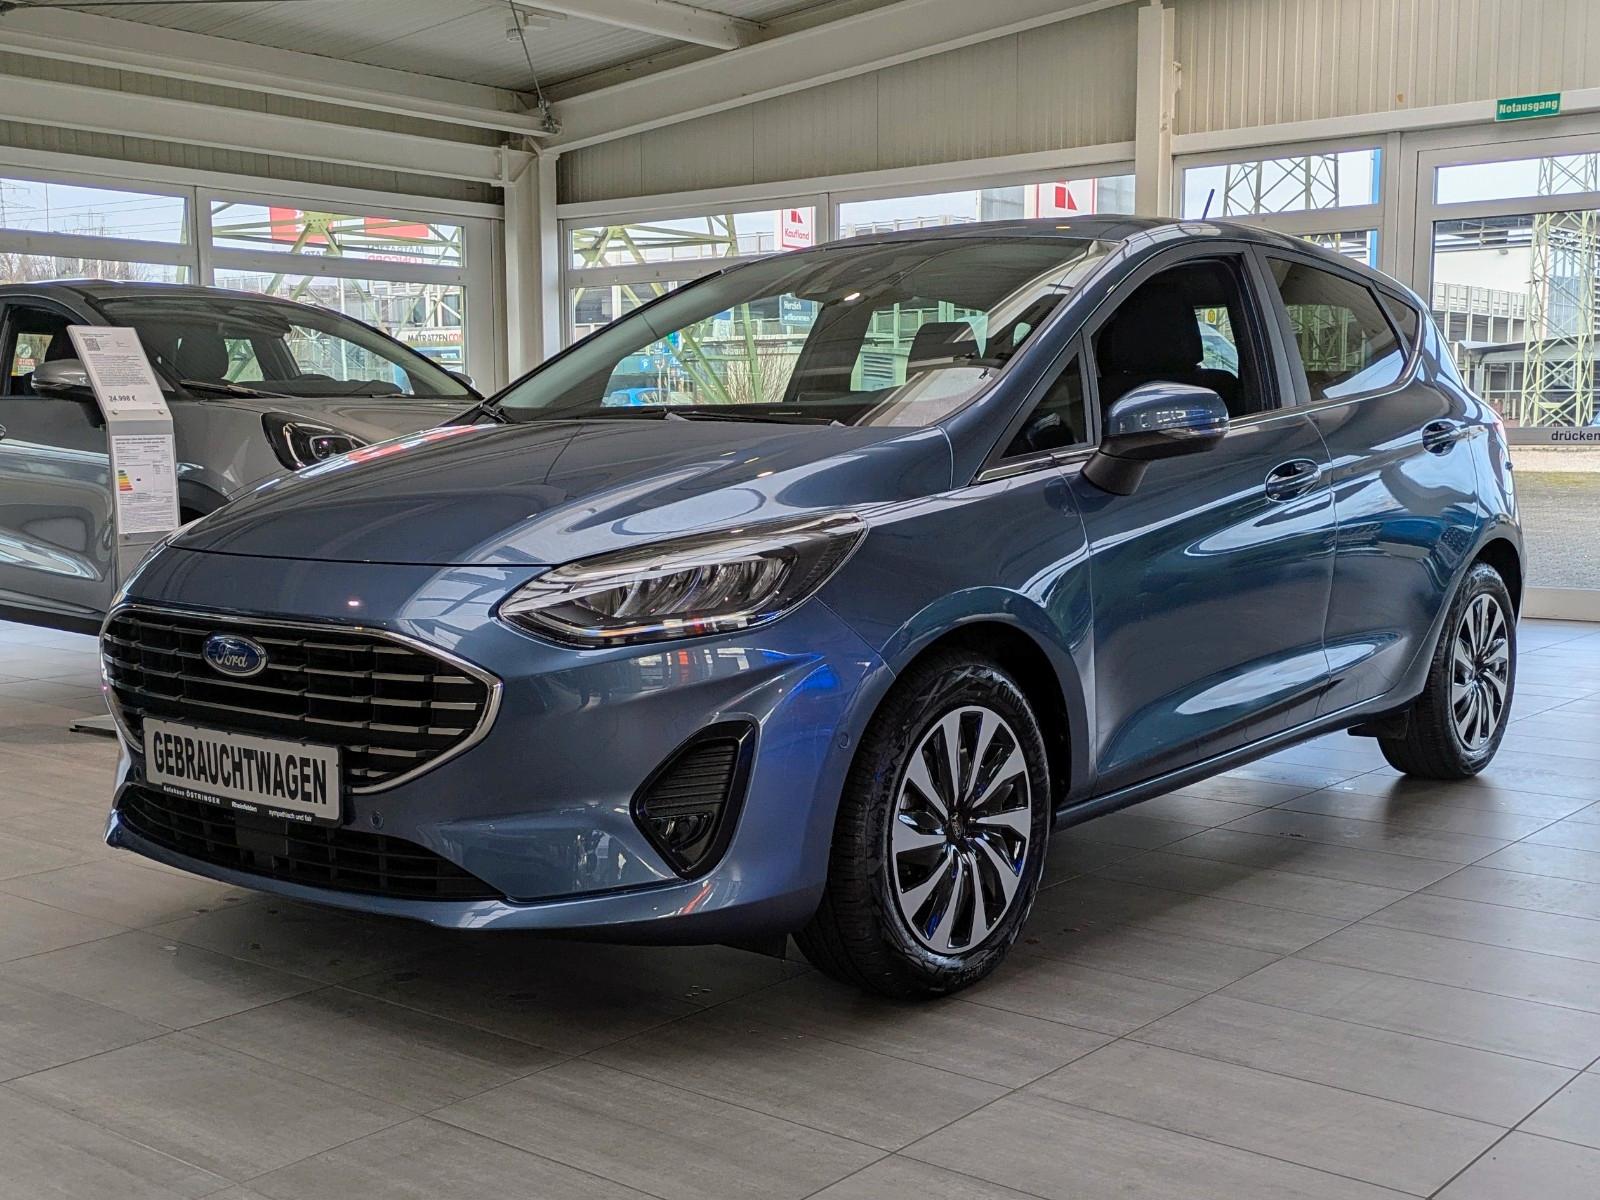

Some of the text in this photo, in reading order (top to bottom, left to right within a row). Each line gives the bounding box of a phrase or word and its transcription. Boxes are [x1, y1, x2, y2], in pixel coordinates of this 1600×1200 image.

[1499, 100, 1558, 114] Notausgang
[784, 227, 810, 240] Kaufland
[407, 333, 448, 342] MATRATZEN
[1551, 430, 1600, 441] drücken
[215, 641, 248, 668] Ford
[153, 731, 327, 805] GEBRAUCHTWAGEN
[186, 789, 221, 805] ÖSTRINGER
